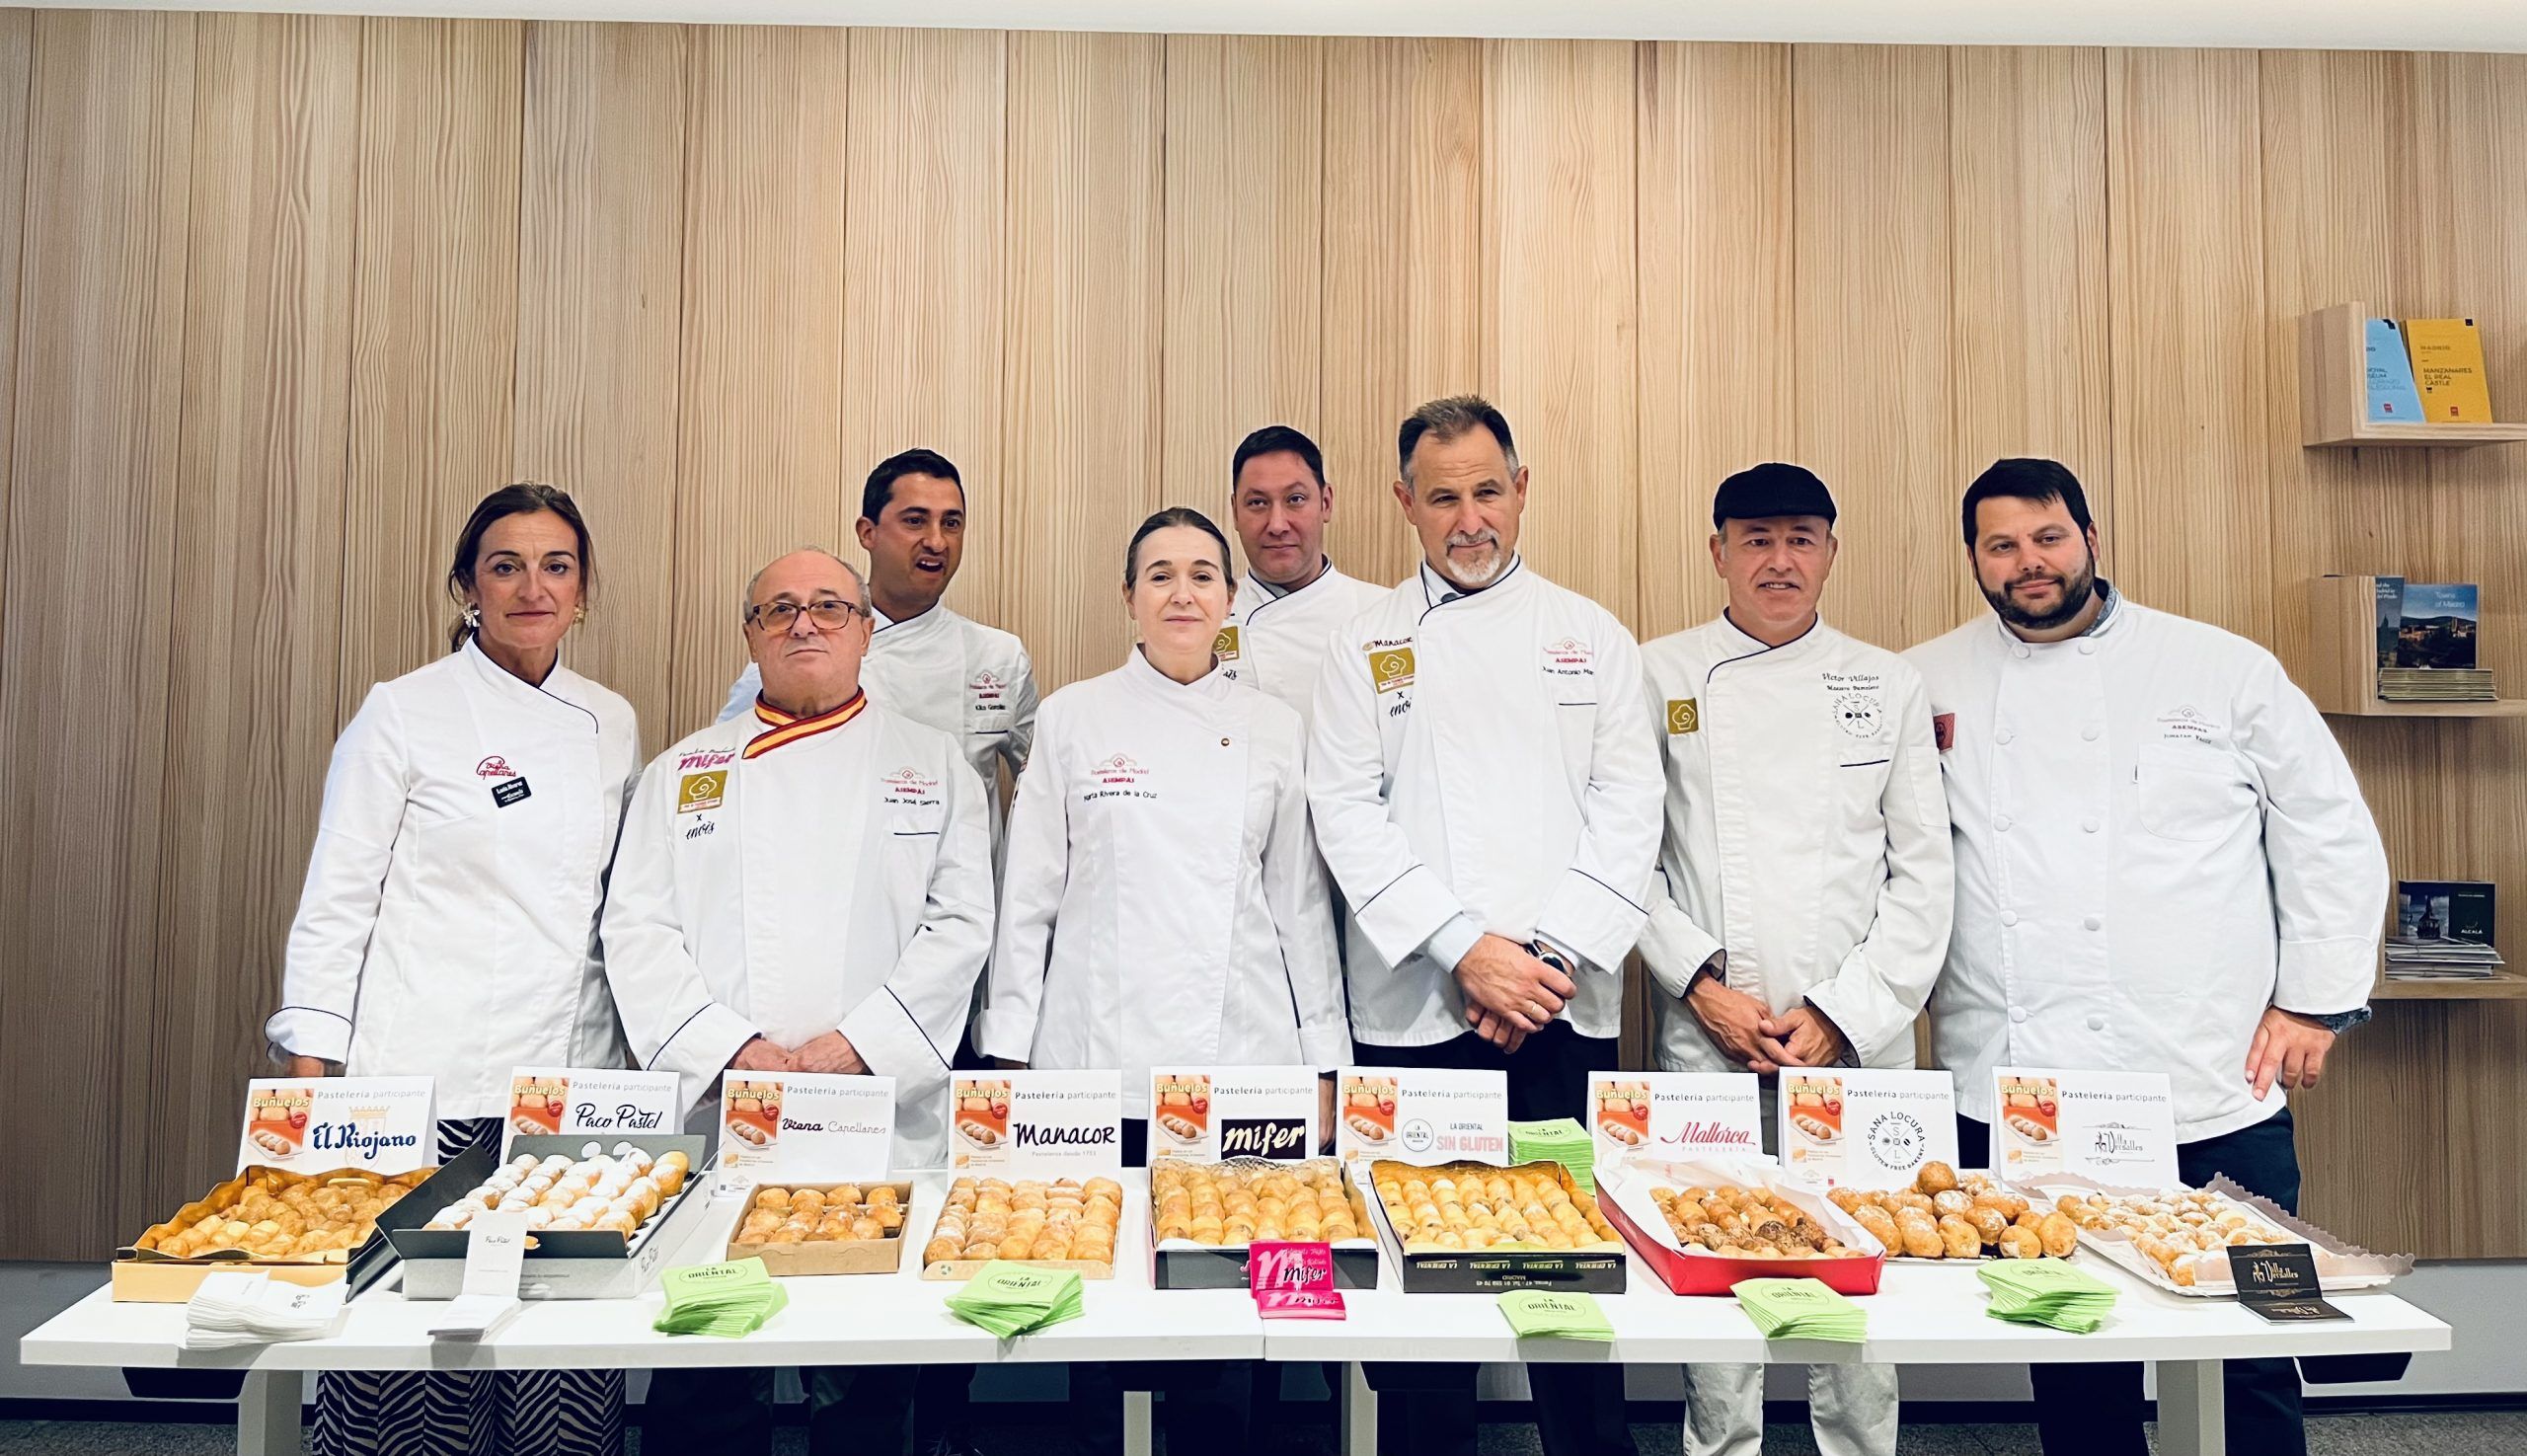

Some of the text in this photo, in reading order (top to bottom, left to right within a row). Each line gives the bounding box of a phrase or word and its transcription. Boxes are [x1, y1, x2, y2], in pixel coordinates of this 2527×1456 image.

[513, 1084, 566, 1096] Buñuelos
[623, 1083, 672, 1093] participante
[727, 1087, 780, 1101] Buñuelos
[839, 1087, 888, 1098] participante
[956, 1087, 1009, 1099] Buñuelos
[1156, 1082, 1208, 1094] Buñuelos
[1264, 1086, 1314, 1096] participante
[1342, 1084, 1395, 1096] Buñuelos
[1596, 1087, 1647, 1100] Buñuelos
[1787, 1083, 1840, 1096] Buñuelos
[2000, 1084, 2054, 1097] Buñuelos
[372, 1089, 426, 1100] participante
[1067, 1090, 1116, 1101] participante
[1453, 1090, 1502, 1101] participante
[1706, 1093, 1755, 1104] participante
[1899, 1090, 1950, 1102] participante
[2115, 1092, 2167, 1104] participante
[253, 1096, 309, 1108] Buñuelos
[575, 1103, 663, 1129] Paco Pastel
[782, 1117, 823, 1132] Viena
[1458, 1122, 1484, 1131] ORIENTAL
[1868, 1111, 1926, 1142] SANA LOCURA
[1222, 1121, 1305, 1156] mifer
[1660, 1121, 1756, 1146] Mallorca
[334, 1121, 417, 1160] Riojano
[1436, 1135, 1503, 1153] SIN GLUTEN
[688, 1268, 737, 1279] ORIENTAL
[1284, 1264, 1327, 1283] mifer
[997, 1279, 1041, 1288] ORIENTAL
[1528, 1302, 1576, 1312] ORIENTAL
